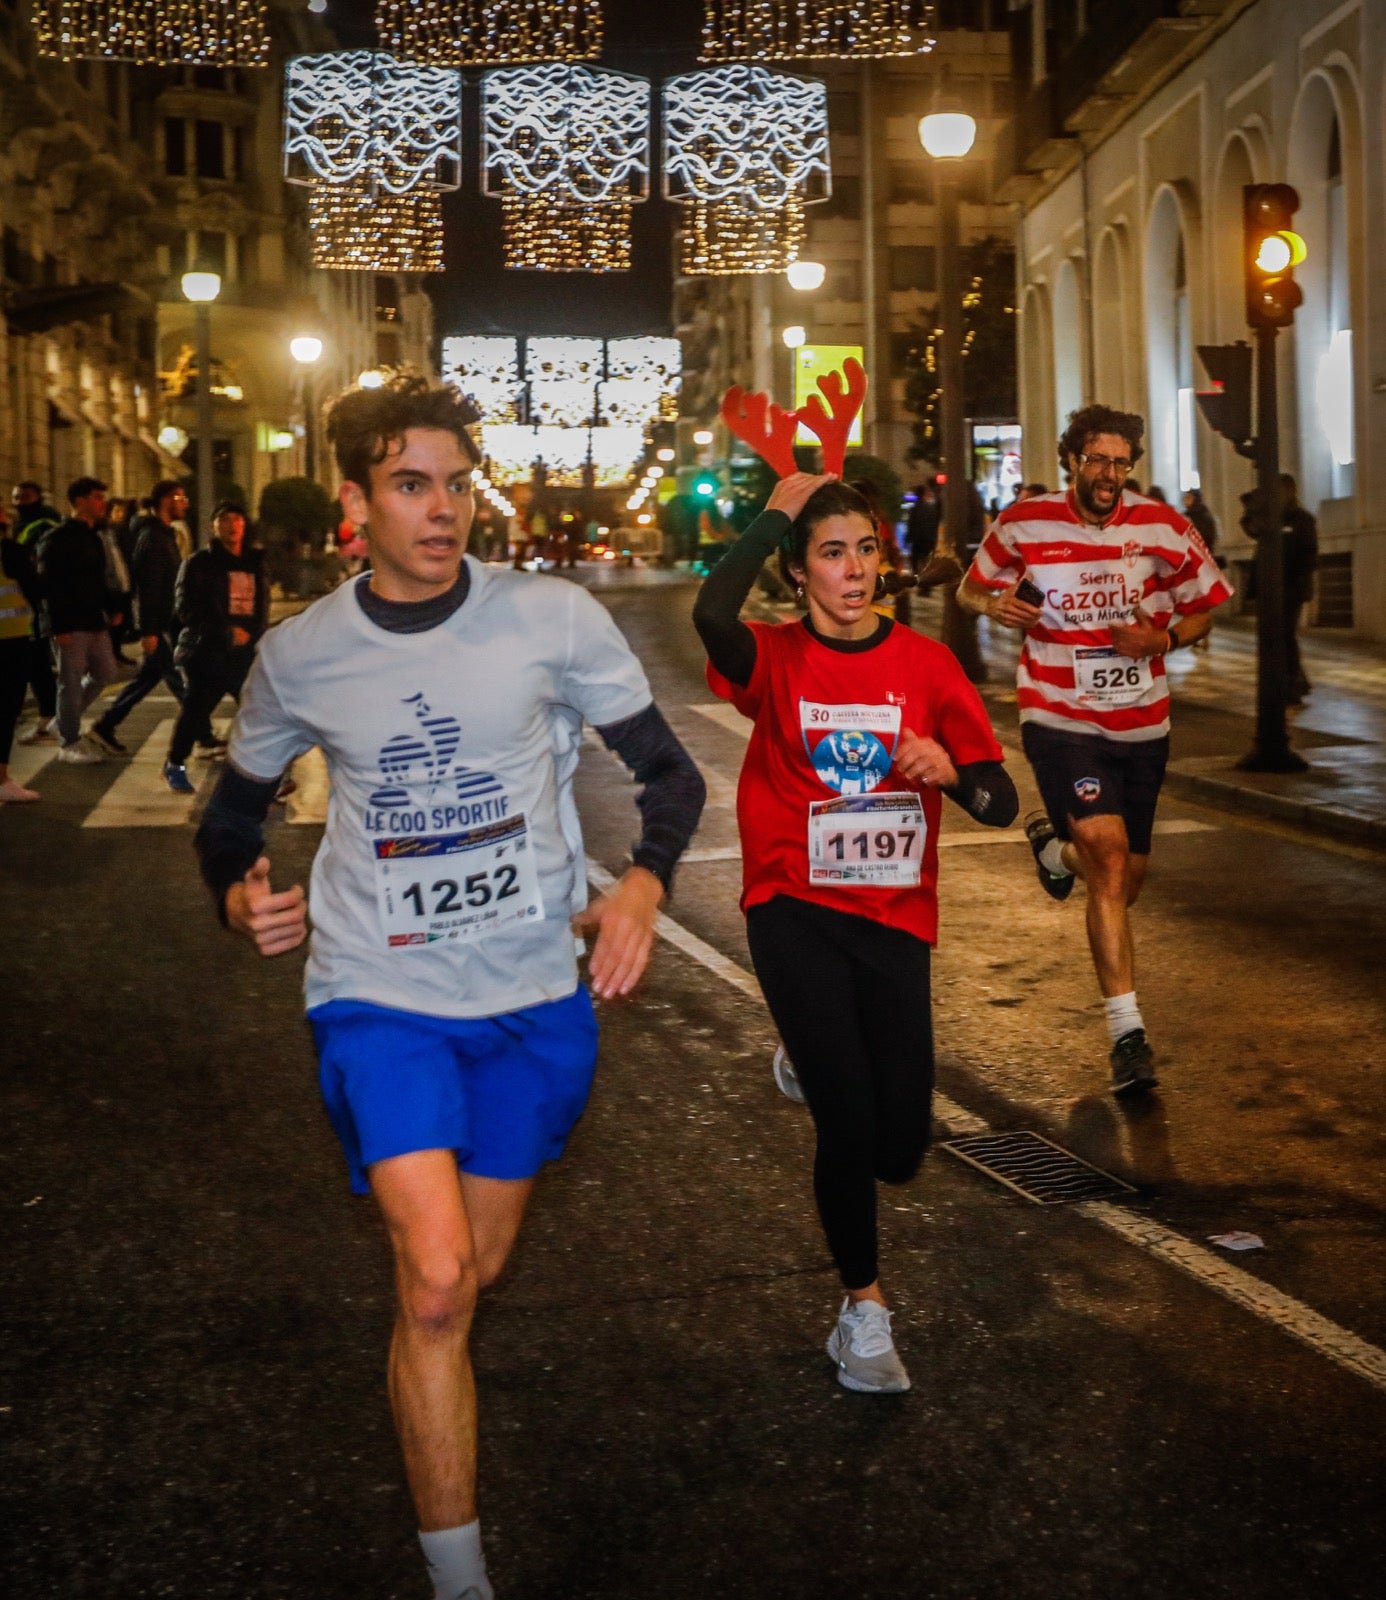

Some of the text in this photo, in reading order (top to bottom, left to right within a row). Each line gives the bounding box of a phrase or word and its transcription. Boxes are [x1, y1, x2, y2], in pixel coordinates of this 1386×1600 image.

[1079, 571, 1125, 586] Sierra
[1046, 584, 1141, 612] Cazorla
[1092, 665, 1140, 689] 526
[810, 708, 830, 722] 30
[365, 796, 509, 833] LE COQ SPORTIF
[828, 830, 916, 860] 1197
[402, 863, 521, 917] 1252
